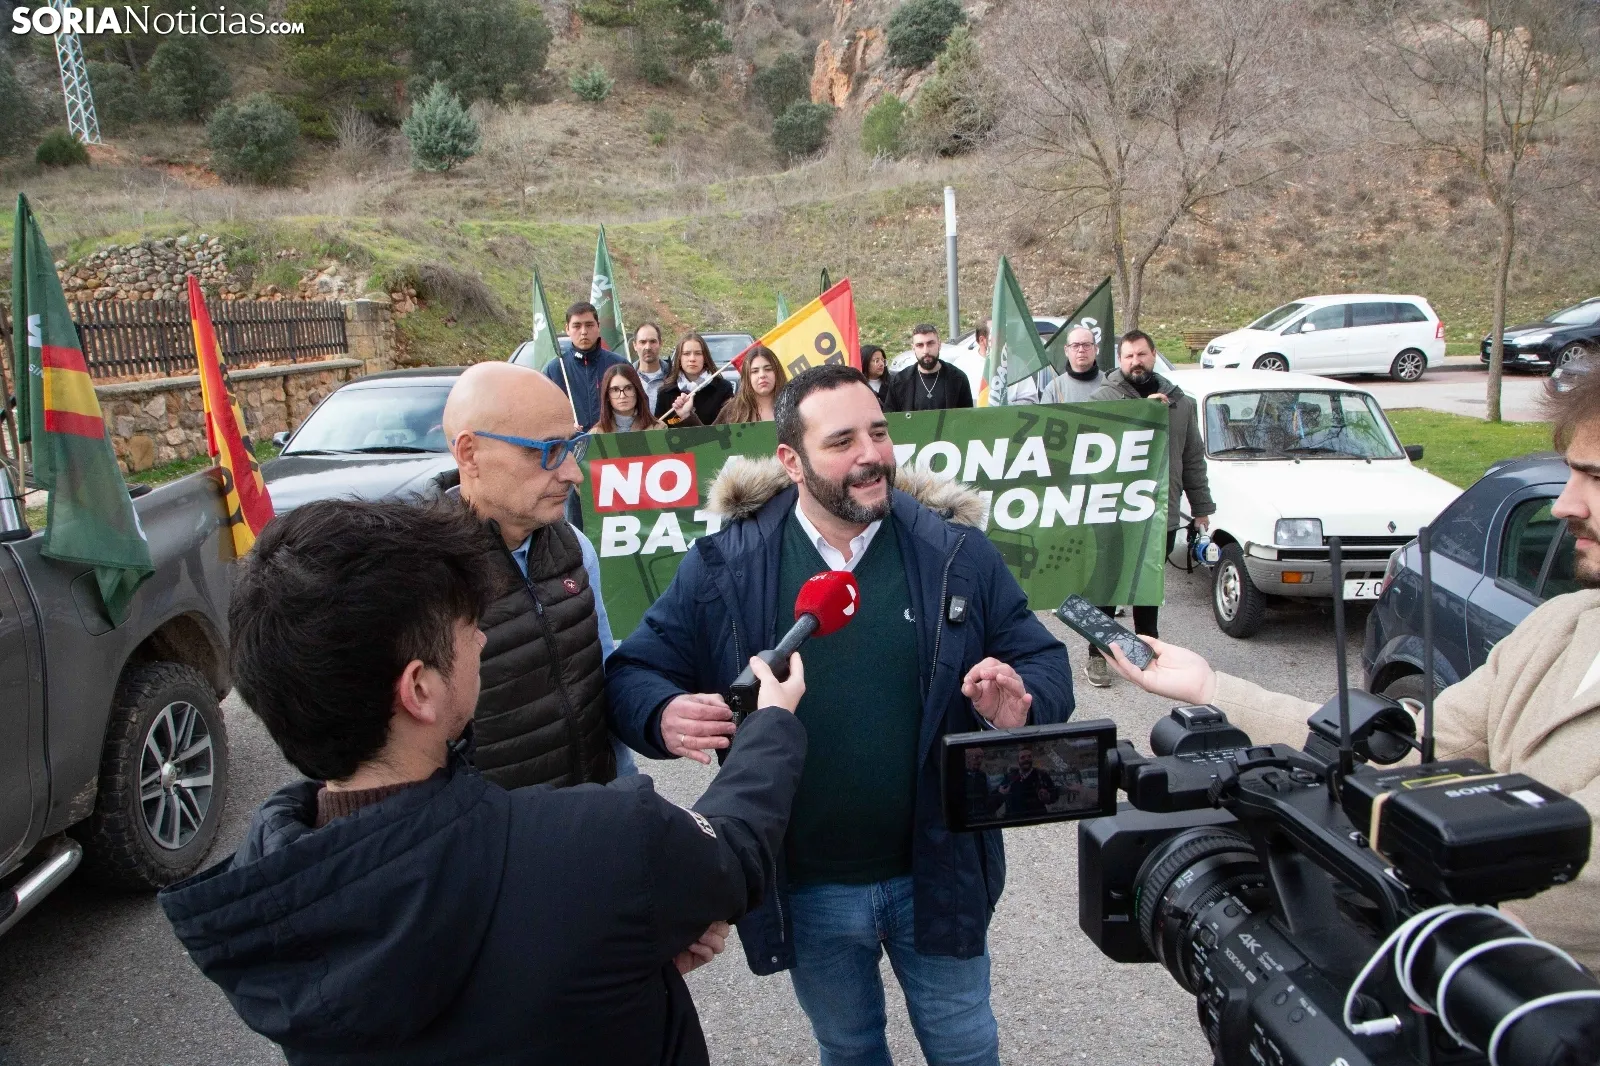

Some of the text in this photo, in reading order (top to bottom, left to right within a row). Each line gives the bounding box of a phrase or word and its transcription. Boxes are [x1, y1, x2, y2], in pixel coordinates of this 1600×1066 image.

[598, 458, 692, 507] NO
[1069, 429, 1155, 476] DE
[599, 479, 1158, 558] BAJ IONES
[1444, 783, 1502, 798] SONY
[1238, 933, 1262, 954] 4K
